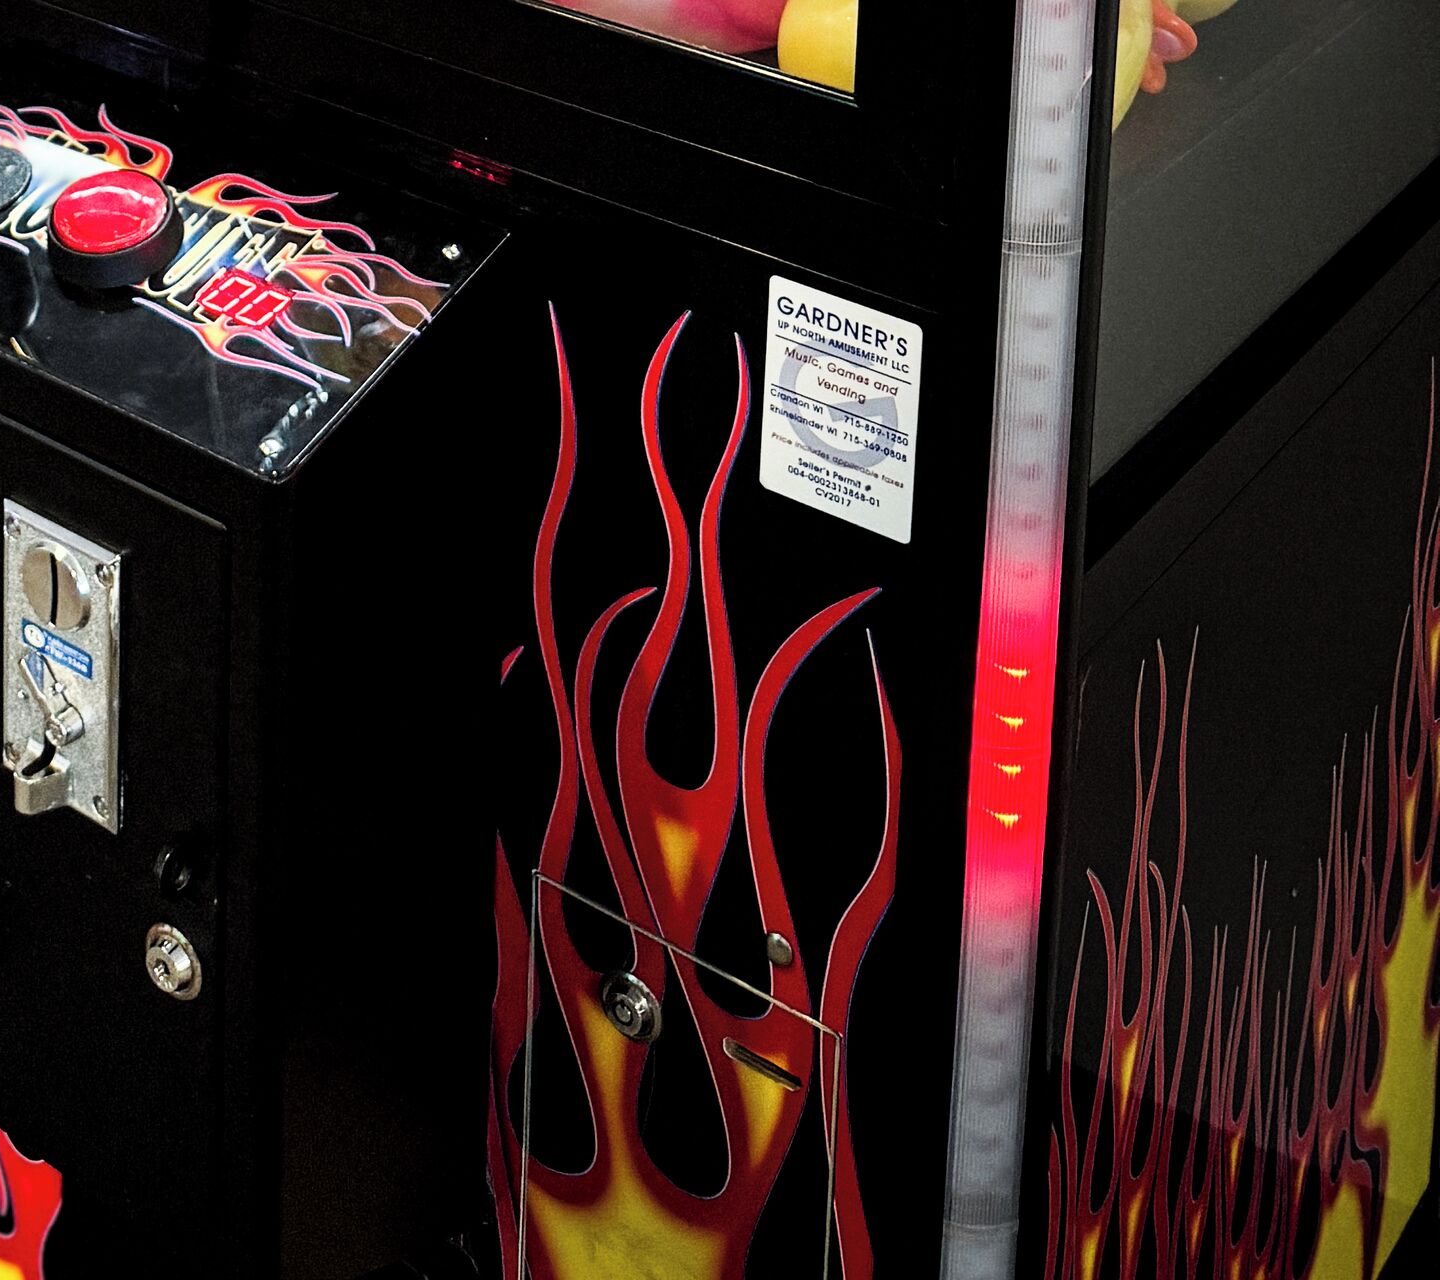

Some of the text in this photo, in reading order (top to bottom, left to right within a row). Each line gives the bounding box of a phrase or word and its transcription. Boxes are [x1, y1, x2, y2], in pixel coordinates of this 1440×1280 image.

[777, 296, 908, 357] GARDNER'S
[777, 320, 910, 374] UP NORTH AMUSEMENT LLC
[784, 347, 899, 396] Music, Games and
[817, 376, 867, 405] Vending
[770, 388, 810, 410] Crandon
[770, 403, 824, 428] Rhinelander
[771, 432, 904, 489] Price includes applicable taxes
[798, 458, 830, 477] Seller's
[833, 471, 862, 488] Permit
